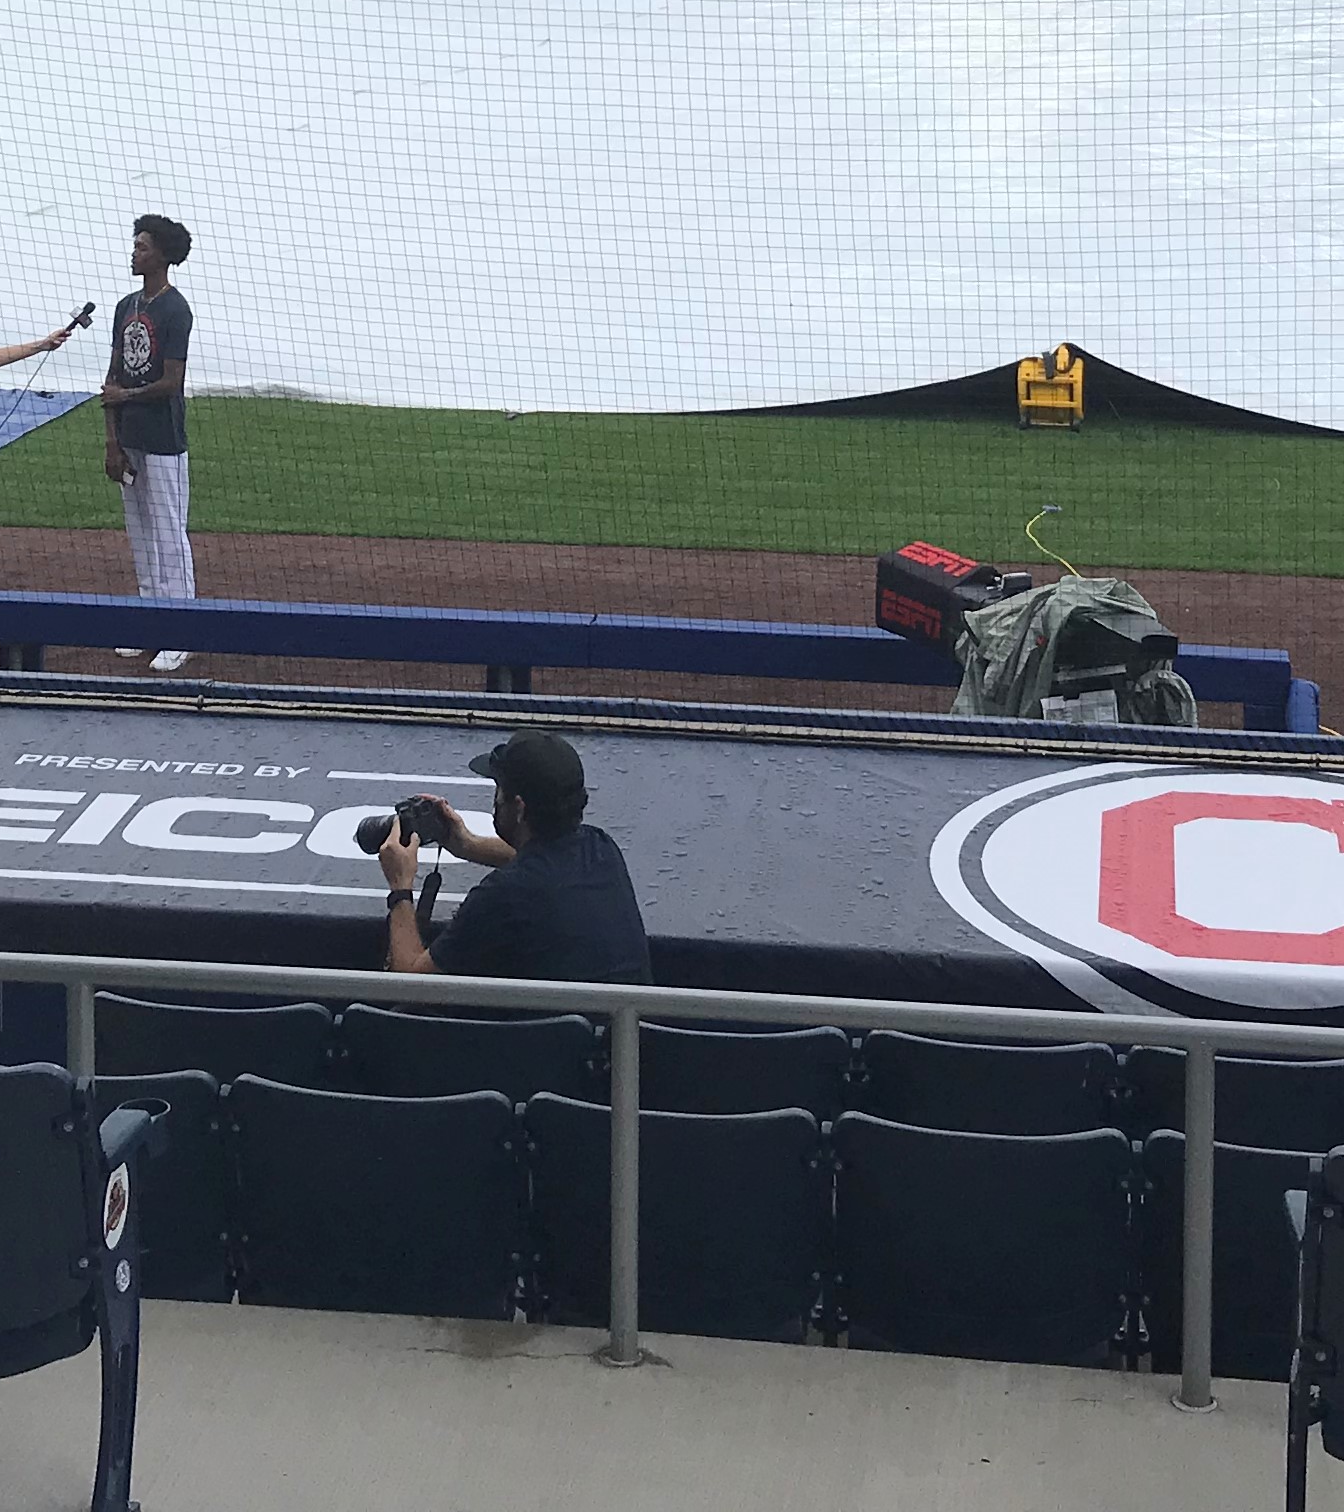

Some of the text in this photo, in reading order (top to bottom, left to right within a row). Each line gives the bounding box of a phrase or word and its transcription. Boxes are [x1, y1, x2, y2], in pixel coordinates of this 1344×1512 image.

[897, 540, 978, 577] ESPN
[881, 589, 942, 639] ESPN
[14, 753, 311, 778] PRESENTED BY
